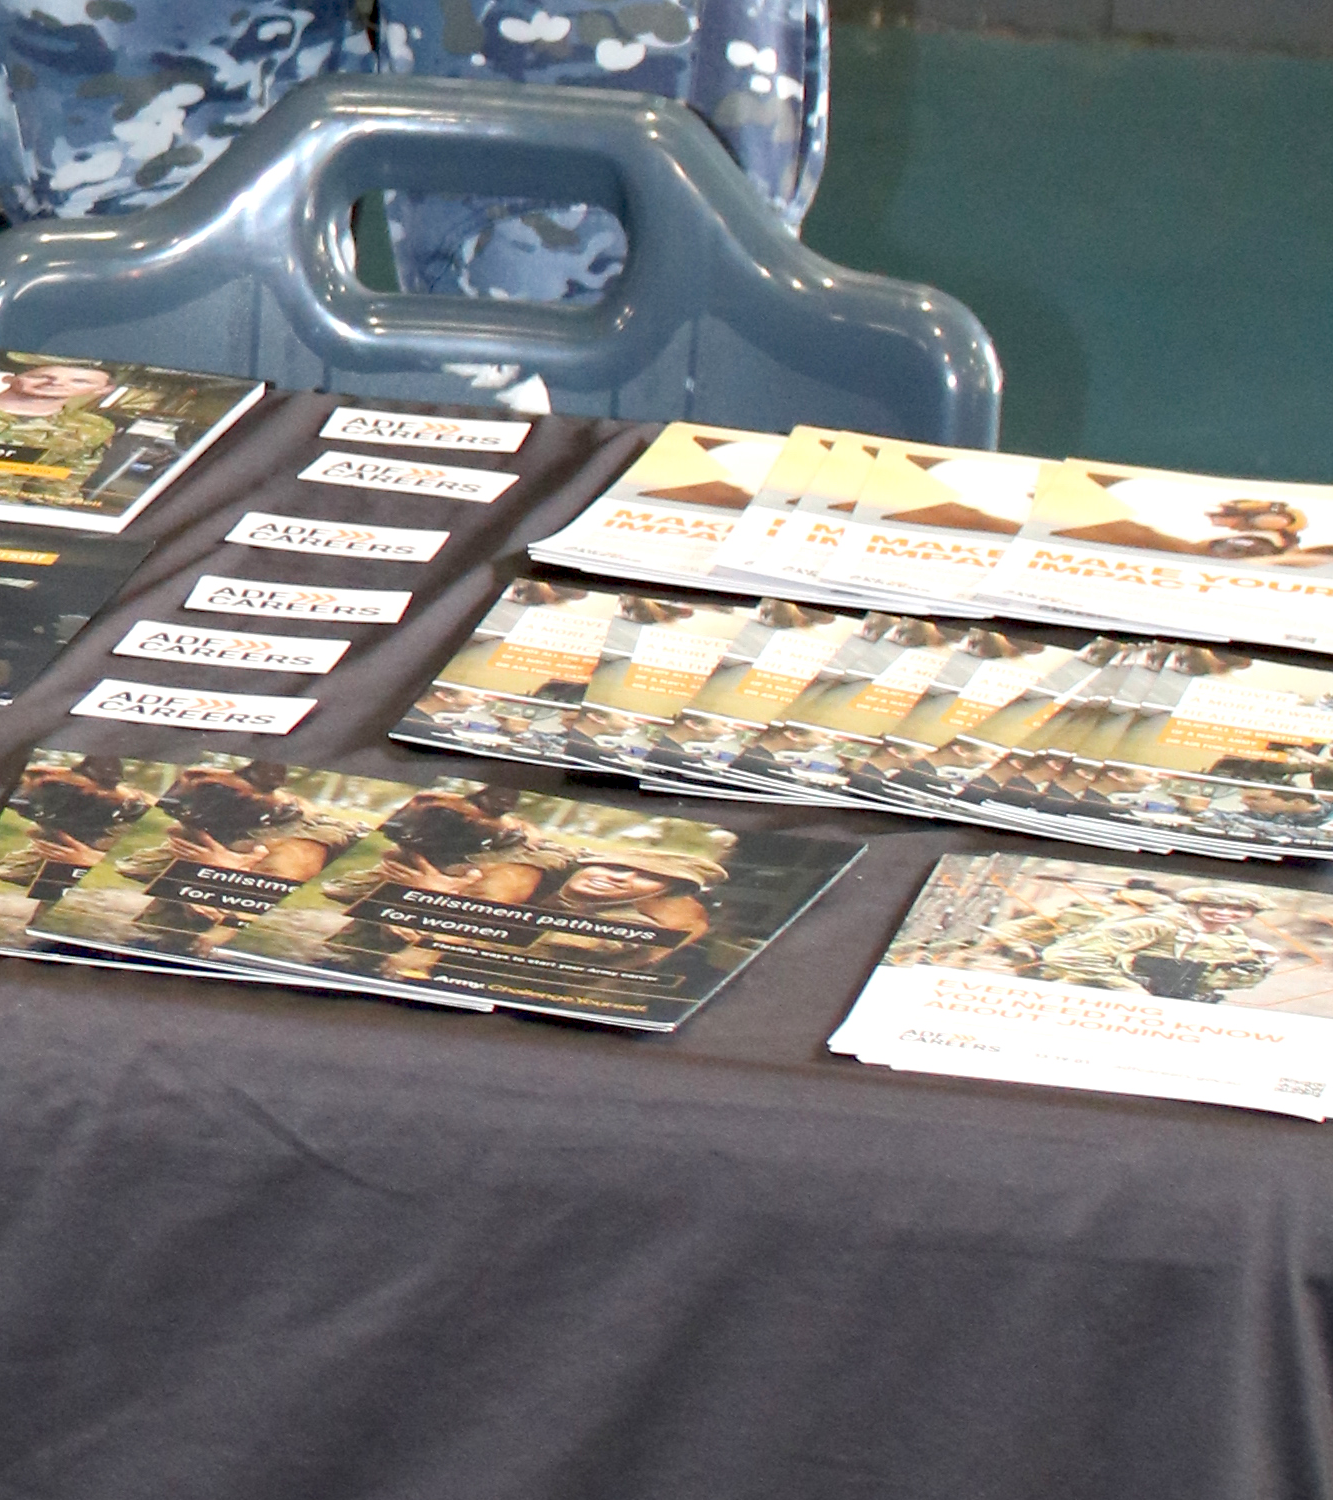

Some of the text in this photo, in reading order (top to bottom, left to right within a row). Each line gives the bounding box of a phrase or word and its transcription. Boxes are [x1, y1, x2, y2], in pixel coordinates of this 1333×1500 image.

[346, 416, 419, 431] ADF
[340, 426, 501, 446] CAREERS
[330, 461, 406, 476] ADF
[321, 469, 482, 494] CAREERS
[256, 523, 332, 537] ADF
[248, 532, 416, 555] CAREERS
[1027, 560, 1224, 595] IMPACT
[1034, 551, 1333, 597] MAKE YOUR
[213, 586, 290, 600] ADF
[207, 596, 381, 616] CAREERS
[145, 632, 226, 647] ADF
[138, 642, 315, 666] CAREERS
[108, 691, 190, 707] ADF
[97, 701, 276, 725] CAREERS
[1182, 708, 1300, 732] HEALTHCARE
[180, 886, 215, 900] for
[380, 908, 510, 940] for women
[403, 891, 658, 943] Enlistment pathways
[433, 941, 659, 983] Flexible ways to start your Army career
[936, 978, 1164, 1017] EVERYTHING
[923, 1000, 1203, 1044] ABOUT JOINING
[934, 990, 1286, 1043] YOU NEED TO KNOW
[898, 1033, 1001, 1053] CAREERS
[902, 1029, 956, 1041] ADF
